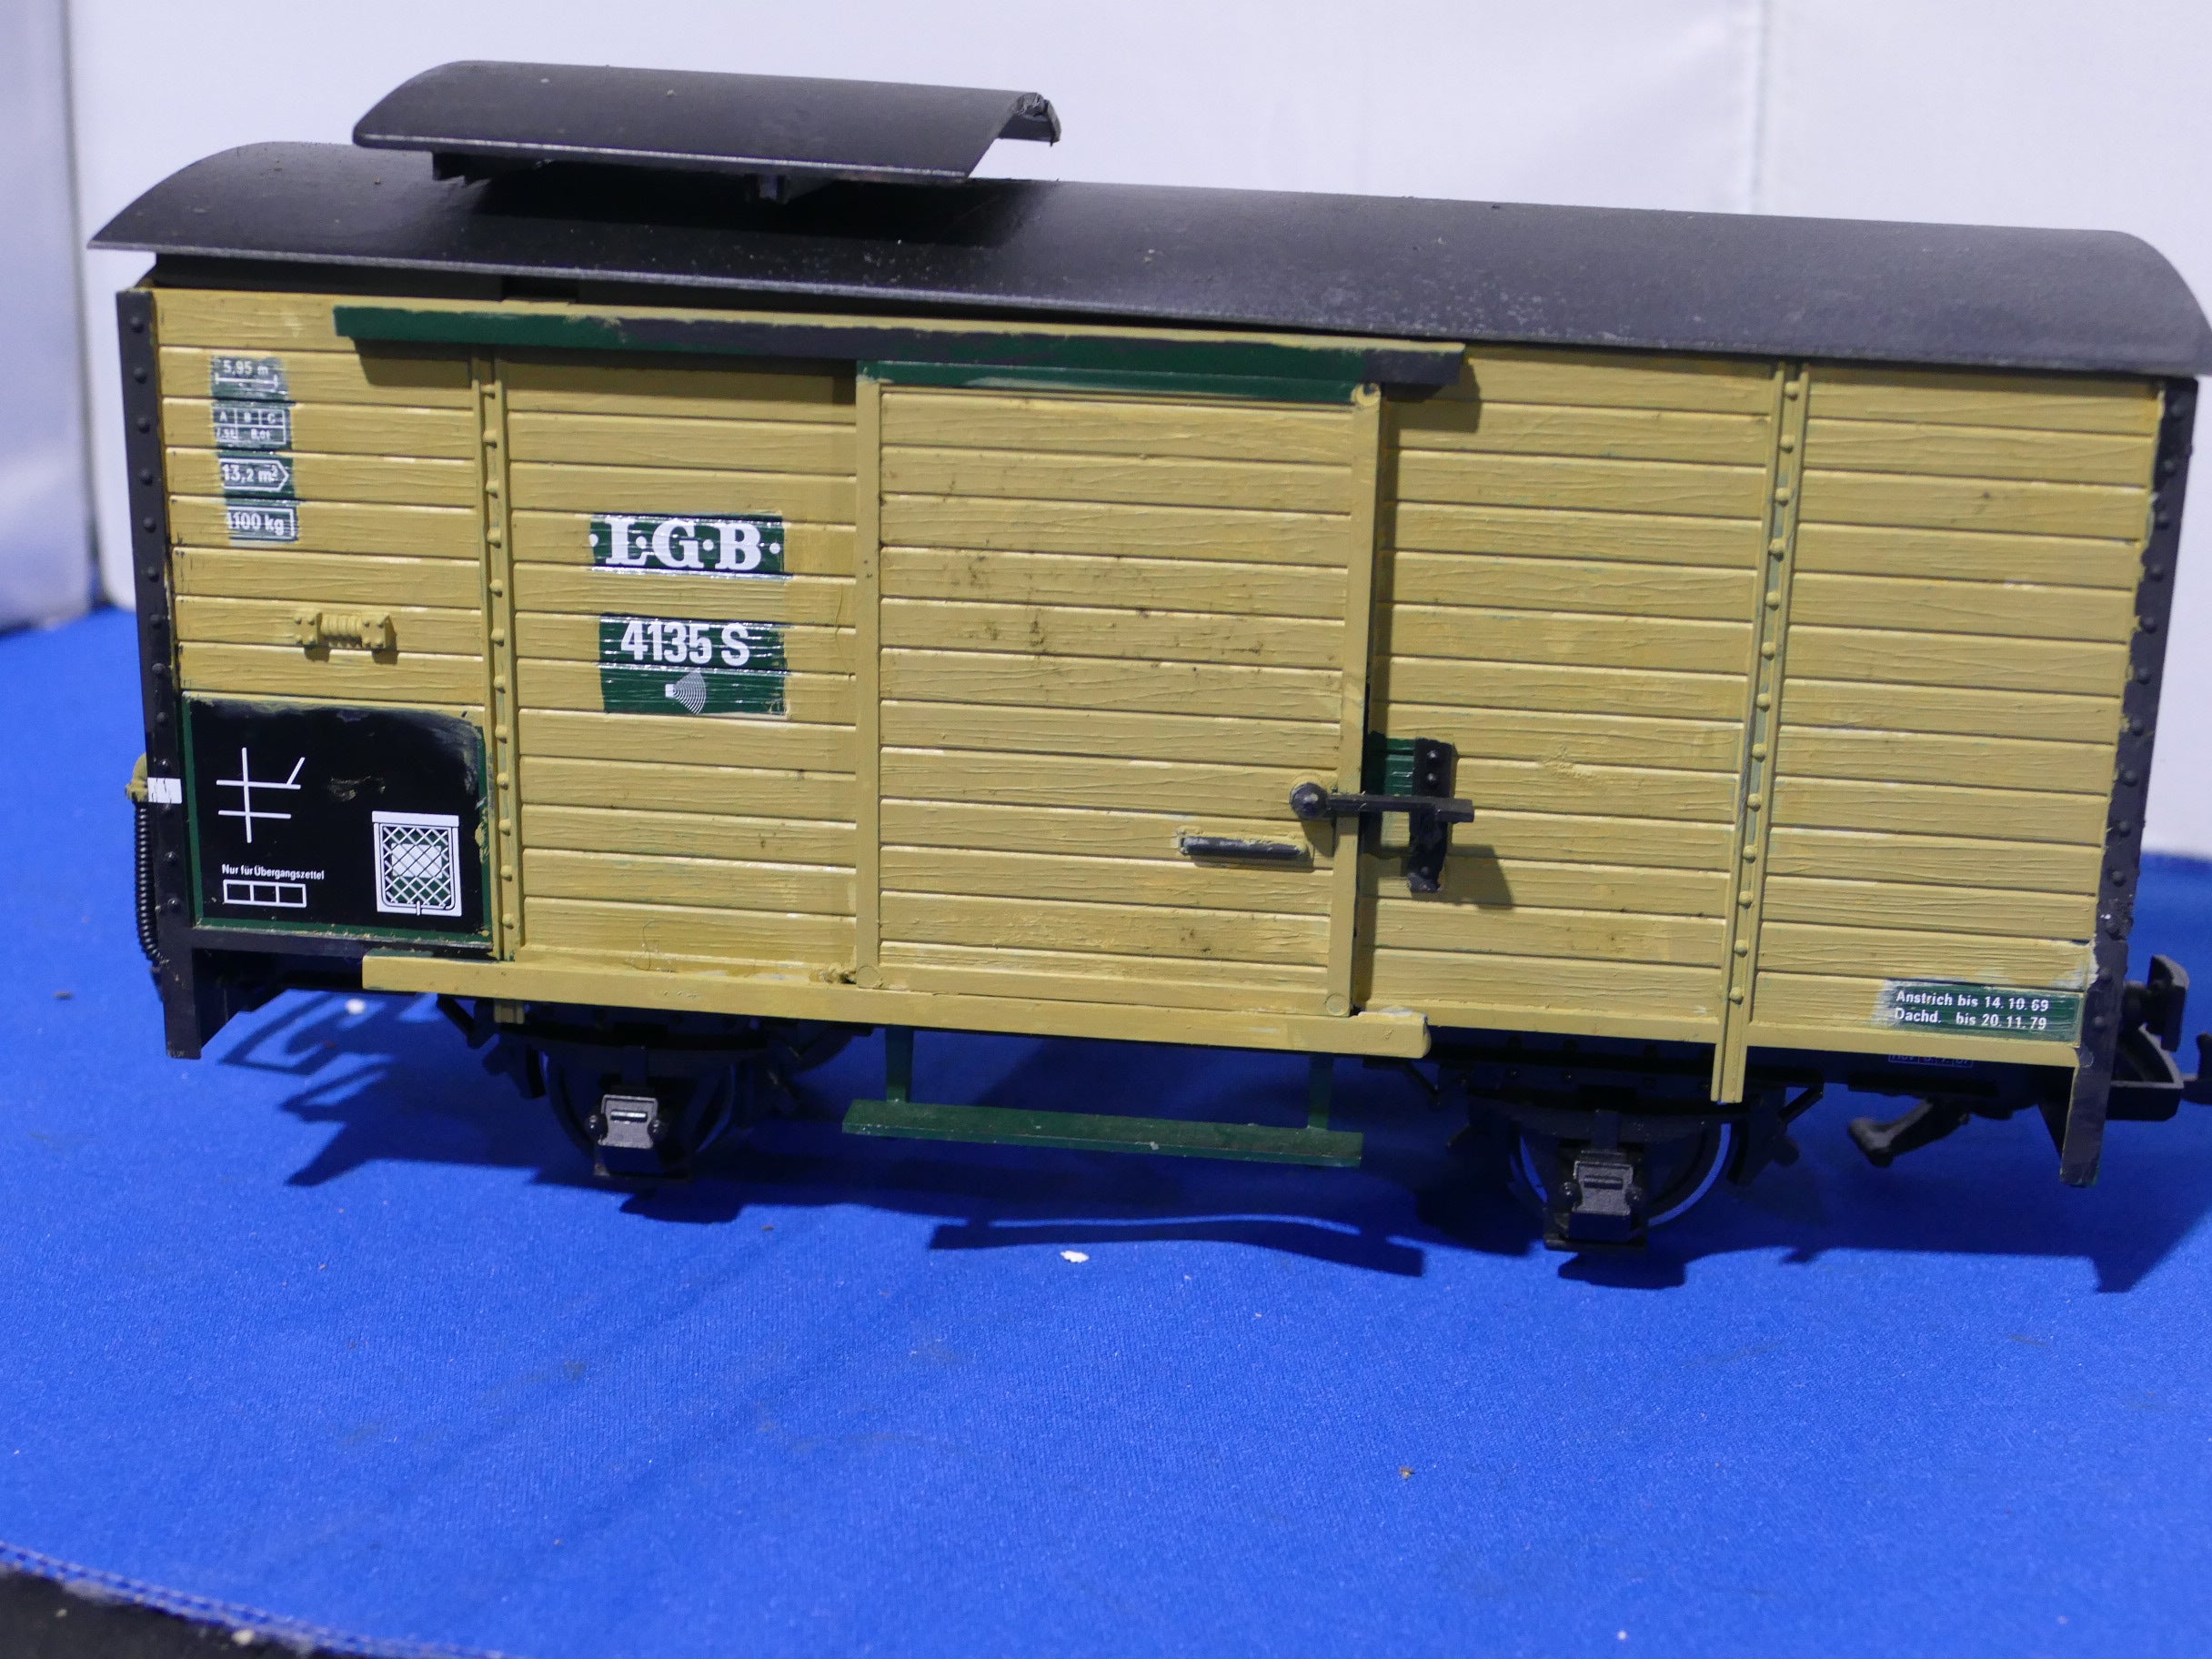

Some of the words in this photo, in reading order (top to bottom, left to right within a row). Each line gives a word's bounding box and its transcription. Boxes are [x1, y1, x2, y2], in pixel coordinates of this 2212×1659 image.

[219, 411, 228, 423] A
[267, 412, 276, 425] C
[265, 514, 285, 536] kg
[620, 620, 713, 665] 4135
[720, 622, 750, 667] S
[222, 864, 239, 875] Nur
[240, 865, 254, 876] für
[255, 864, 325, 881] Übergangszettel
[1895, 990, 1953, 1007] Anstrich
[1957, 994, 1979, 1008] bis
[1894, 1007, 1942, 1024] Dachd.
[1956, 1011, 1976, 1026] bis
